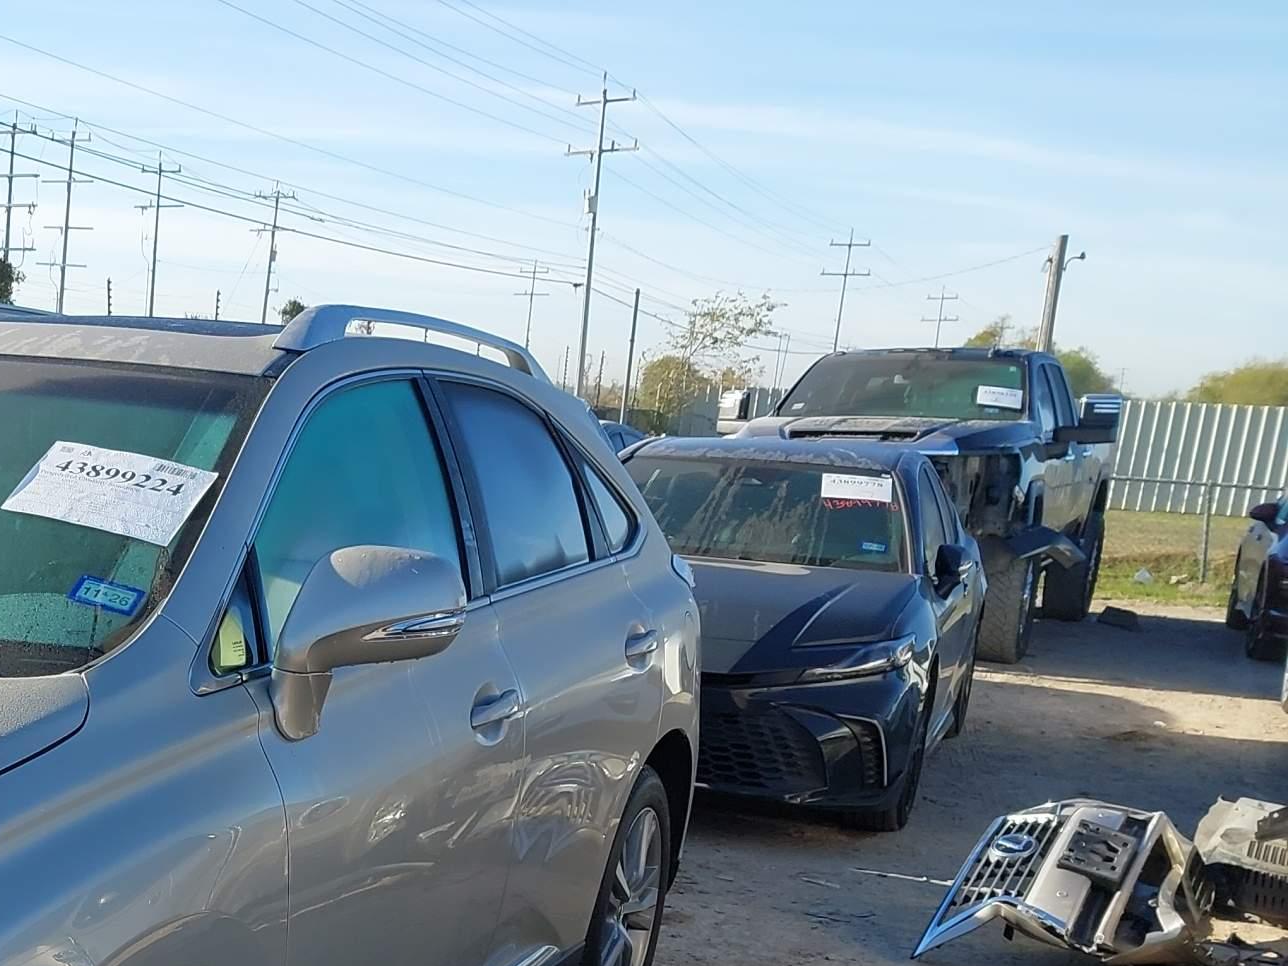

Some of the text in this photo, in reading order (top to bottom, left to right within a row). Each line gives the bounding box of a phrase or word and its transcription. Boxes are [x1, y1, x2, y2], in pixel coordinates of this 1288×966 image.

[55, 458, 186, 497] 43899224
[83, 585, 131, 607] 11 26
